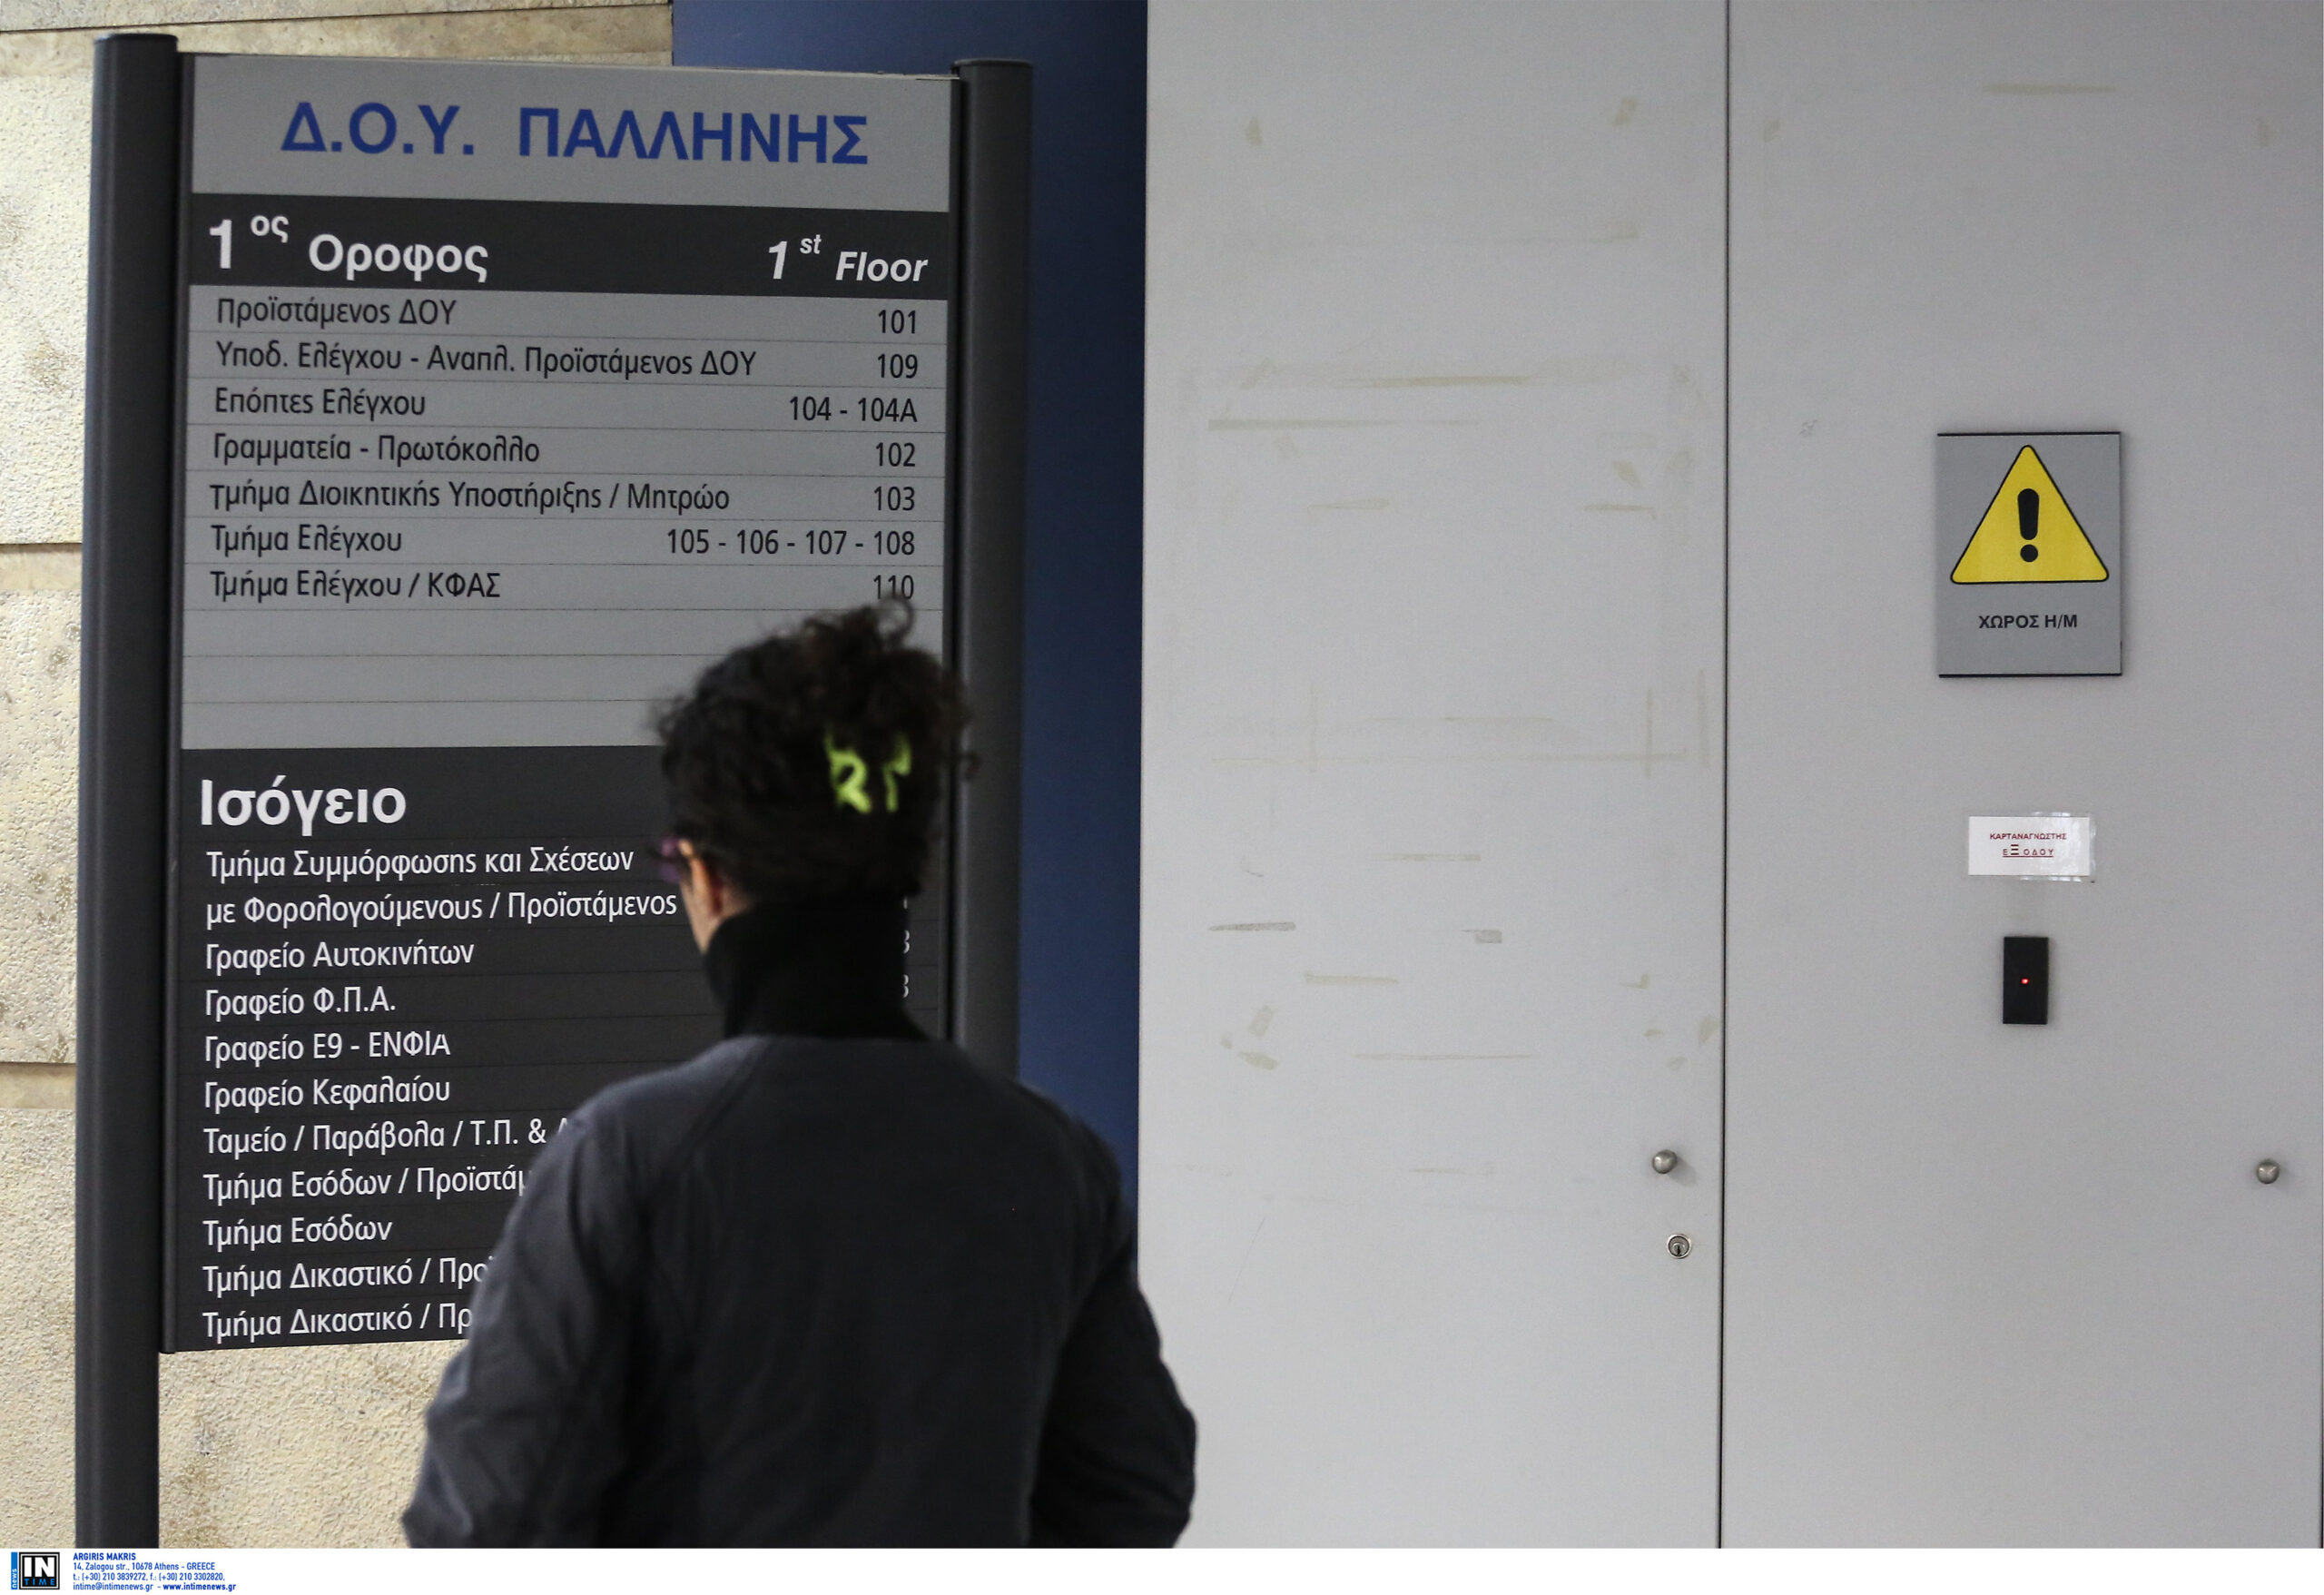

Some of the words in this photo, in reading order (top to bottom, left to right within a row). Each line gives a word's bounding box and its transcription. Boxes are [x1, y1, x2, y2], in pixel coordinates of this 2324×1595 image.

[281, 102, 474, 155] Δ.Ο.Υ.
[519, 107, 868, 165] ΠΑΛΛΗΝΗΣ
[309, 233, 488, 283] Οροφος
[835, 251, 929, 282] Floor
[217, 296, 390, 330] Προϊστάμενος
[399, 299, 457, 325] ΔΟΥ
[878, 309, 916, 334] 101
[216, 340, 288, 368] Υποδ.
[299, 340, 401, 376] Ελέγχου
[427, 344, 515, 372] Αναπλ.
[526, 346, 693, 380] Προϊστάμενος
[700, 350, 756, 376] ΔΟΥ
[877, 353, 919, 379] 109
[215, 387, 313, 414] Επόπτες
[322, 387, 426, 422] Ελέγχου
[789, 396, 832, 421] 104
[214, 432, 350, 467] Γραμματεία
[379, 435, 540, 468] Πρωτόκολλο
[875, 442, 916, 468] 102
[209, 478, 290, 512] Τμήμα
[299, 479, 440, 507] Διοικητικής
[448, 480, 602, 516] Υποστήριξης
[627, 483, 730, 517] Μητρώο
[873, 486, 915, 511] 103
[210, 524, 289, 558] Τμήμα
[298, 524, 402, 558] Ελέγχου
[667, 528, 710, 554] 105
[736, 529, 779, 555] 106
[805, 529, 847, 556] 107
[873, 530, 915, 556] 108
[210, 569, 288, 604] Τμήμα
[297, 569, 401, 604] Ελέγχου
[428, 572, 500, 598] ΚΦΑΣ
[873, 575, 914, 601] 110
[1978, 615, 2040, 629] ΧΩΡΟΣ
[2044, 614, 2077, 629] Η/Μ
[201, 774, 407, 837] Ισόγειο
[206, 849, 285, 884] Τμήμα
[293, 848, 477, 883] Συμμόρφωσης
[485, 852, 521, 873] και
[529, 845, 635, 872] Σχέσεων
[2003, 844, 2053, 855] ΕΞΟΔΟΥ
[207, 903, 236, 930] με
[243, 893, 483, 930] Φορολογούμενους
[508, 890, 677, 924] Προϊστάμενος
[206, 941, 305, 977] Γραφείο
[312, 939, 475, 968] Αυτοκινήτων
[206, 987, 305, 1023] Γραφείο
[313, 985, 396, 1013] Φ.Π.Α.
[205, 1033, 304, 1069] Γραφείο
[313, 1032, 342, 1058] Ε9
[369, 1030, 451, 1058] ΕΝΦΙΑ
[205, 1078, 304, 1115] Γραφείο
[313, 1075, 450, 1111] Κεφαλαίου
[202, 1126, 287, 1160] Ταμείο
[313, 1119, 445, 1157] Παράβολα
[469, 1119, 518, 1146] Τ.Π.
[527, 1117, 547, 1144] &
[202, 1172, 282, 1206] Τμήμα
[291, 1167, 392, 1197] Εσόδων
[202, 1218, 281, 1252] Τμήμα
[291, 1213, 393, 1243] Εσόδων
[202, 1265, 281, 1299] Τμήμα
[290, 1257, 413, 1289] Δικαστικό
[439, 1255, 494, 1289] Προ
[202, 1310, 281, 1344] Τμήμα
[289, 1303, 413, 1334] Δικαστικό
